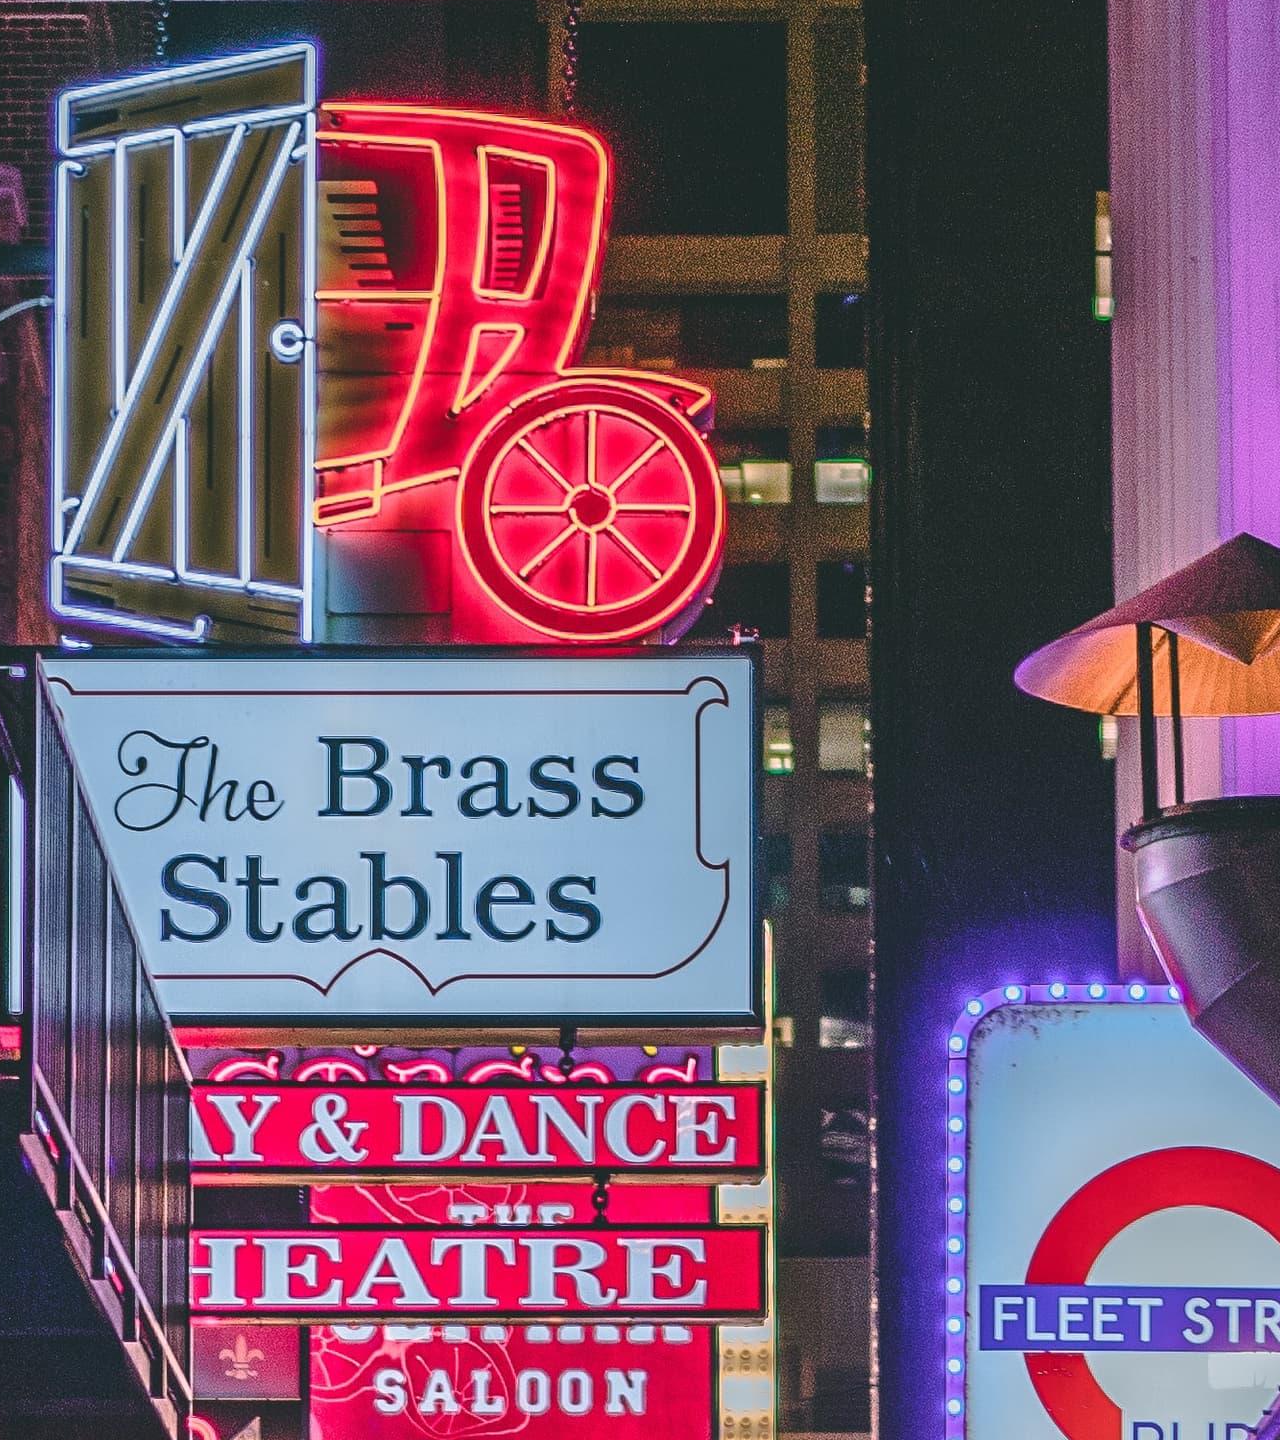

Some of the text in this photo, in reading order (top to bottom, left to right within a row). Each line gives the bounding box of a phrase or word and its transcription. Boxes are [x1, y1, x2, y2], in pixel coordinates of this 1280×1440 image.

[115, 730, 645, 832] The Brass
[160, 851, 604, 944] Stables
[299, 1094, 368, 1164] &
[393, 1094, 737, 1164] DANCE
[993, 1297, 1163, 1344] FLEET
[373, 1368, 650, 1416] SALOON
